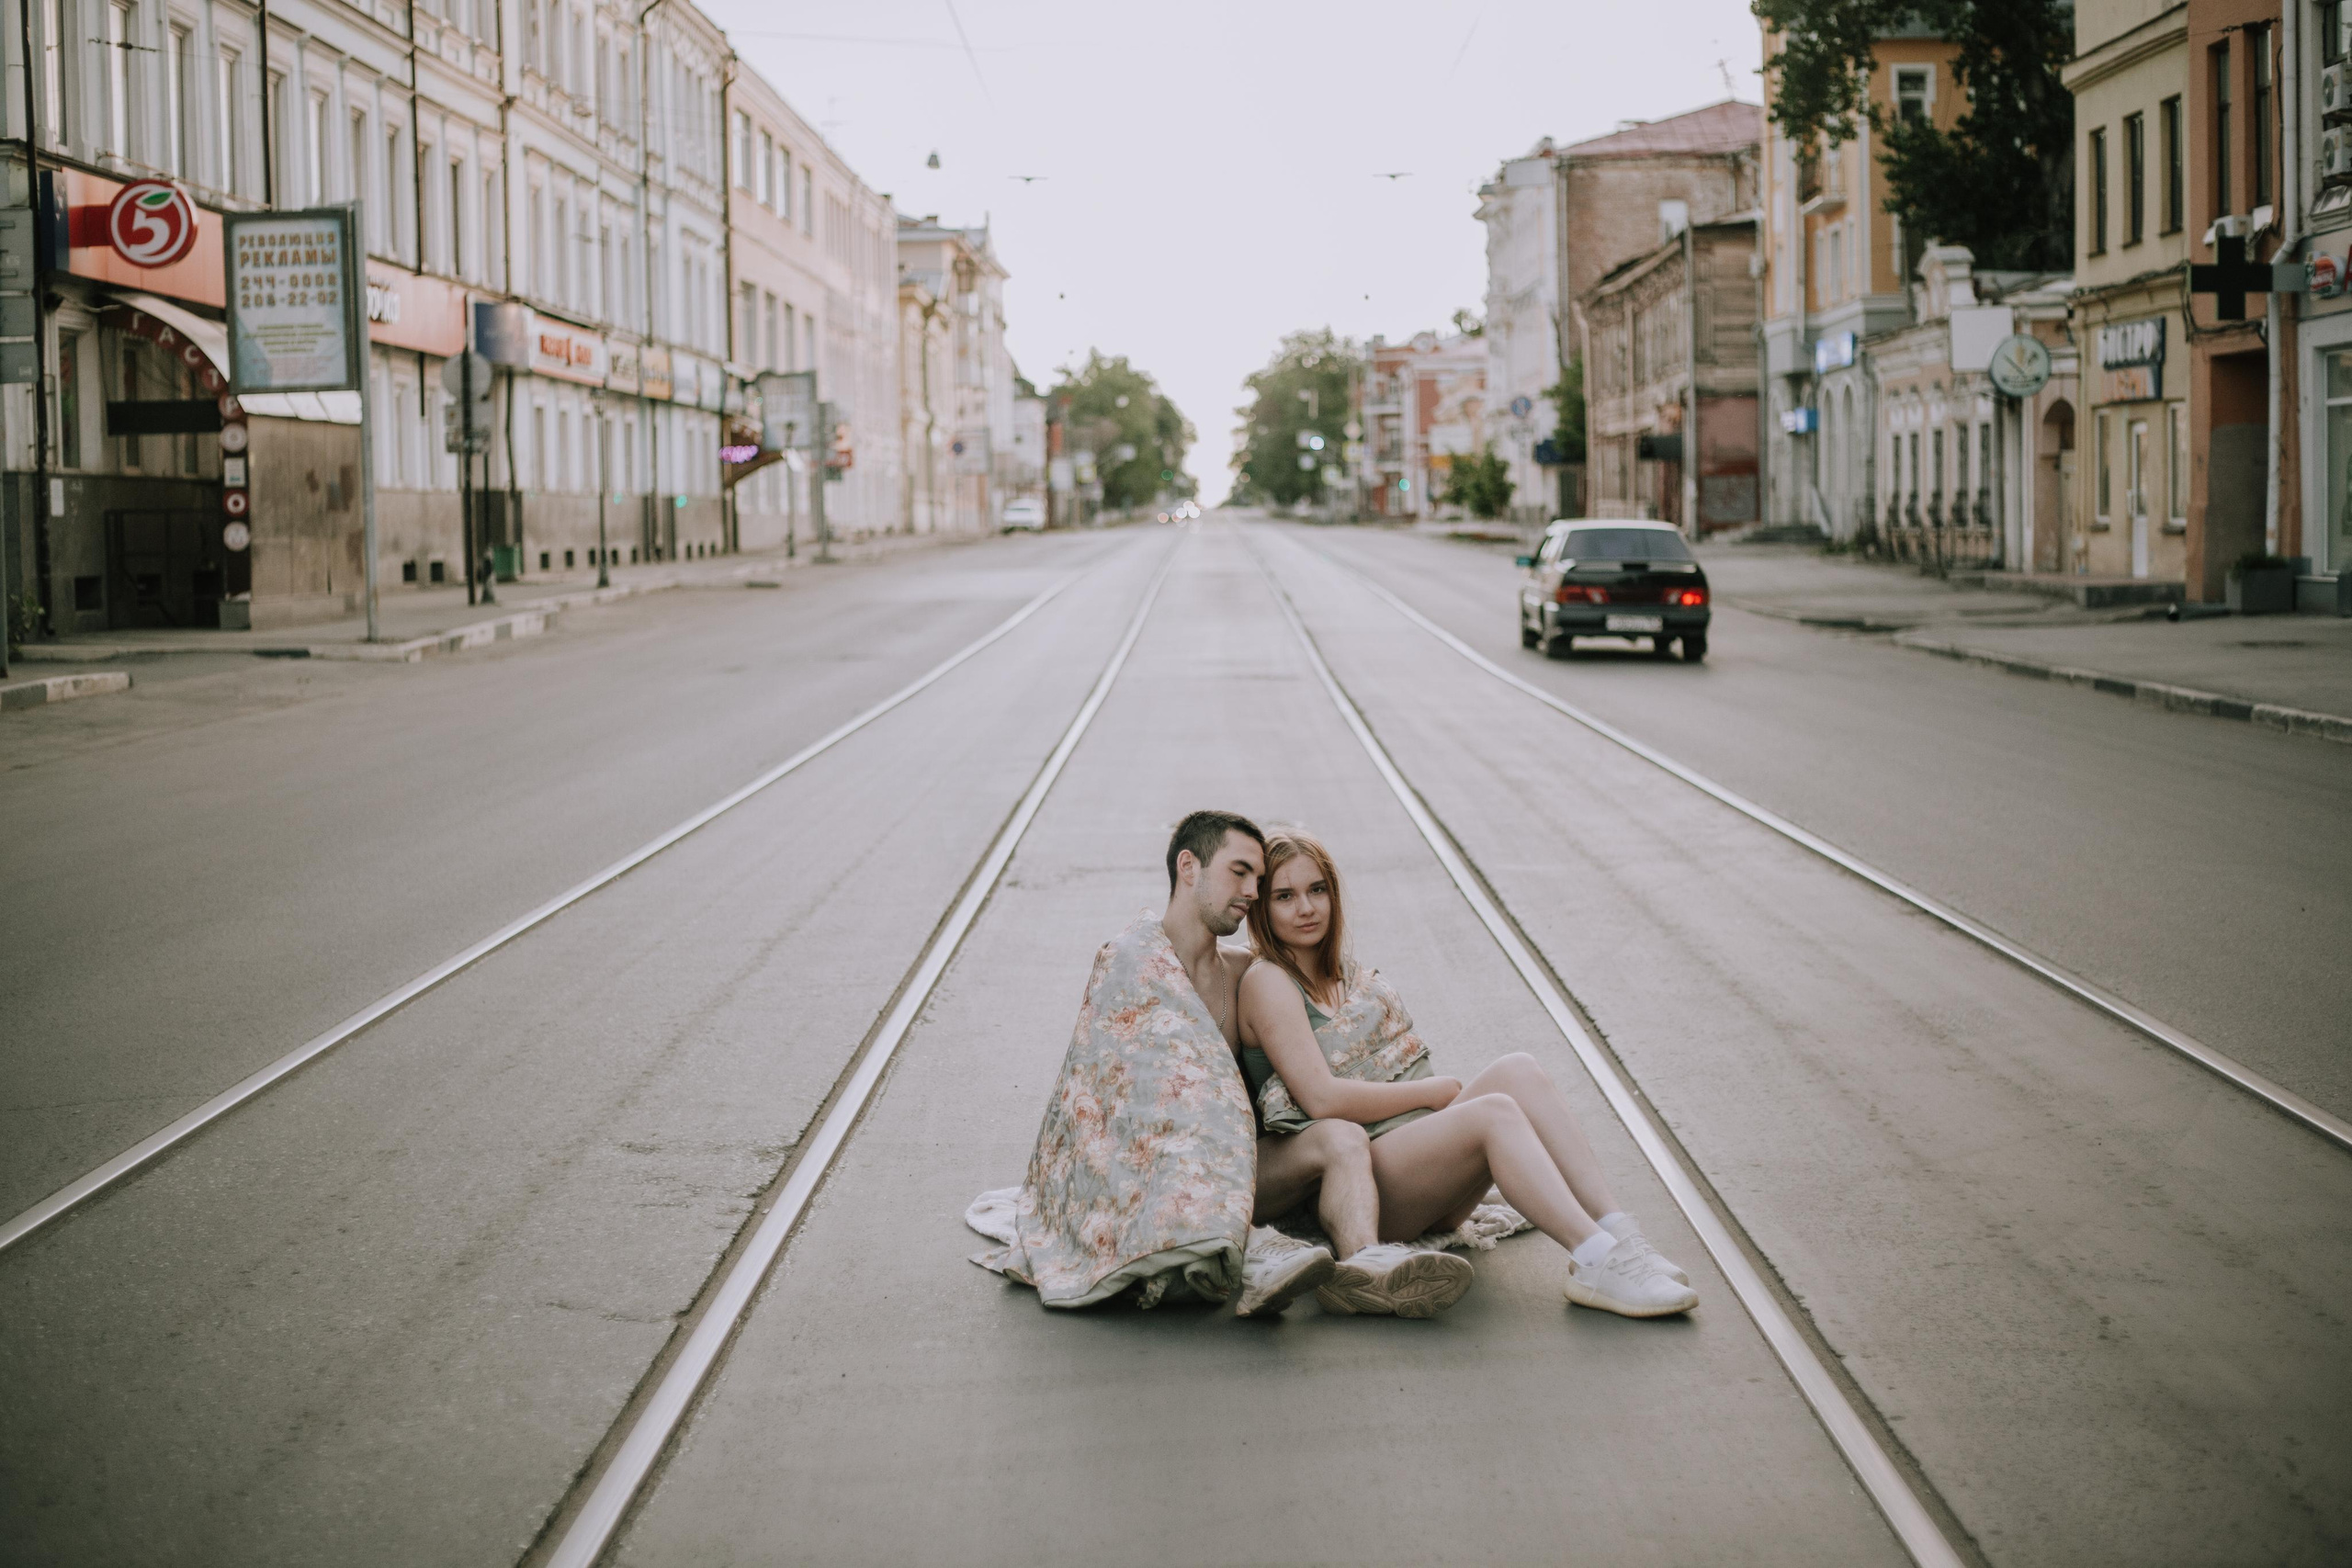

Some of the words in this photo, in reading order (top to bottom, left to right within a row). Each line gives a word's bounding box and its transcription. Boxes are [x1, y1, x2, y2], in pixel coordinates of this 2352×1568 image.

[239, 232, 336, 247] РЕВОЛЮЦИЯ
[240, 248, 336, 267] РЕКЛАМЫ
[2097, 320, 2161, 365] БИСТРО
